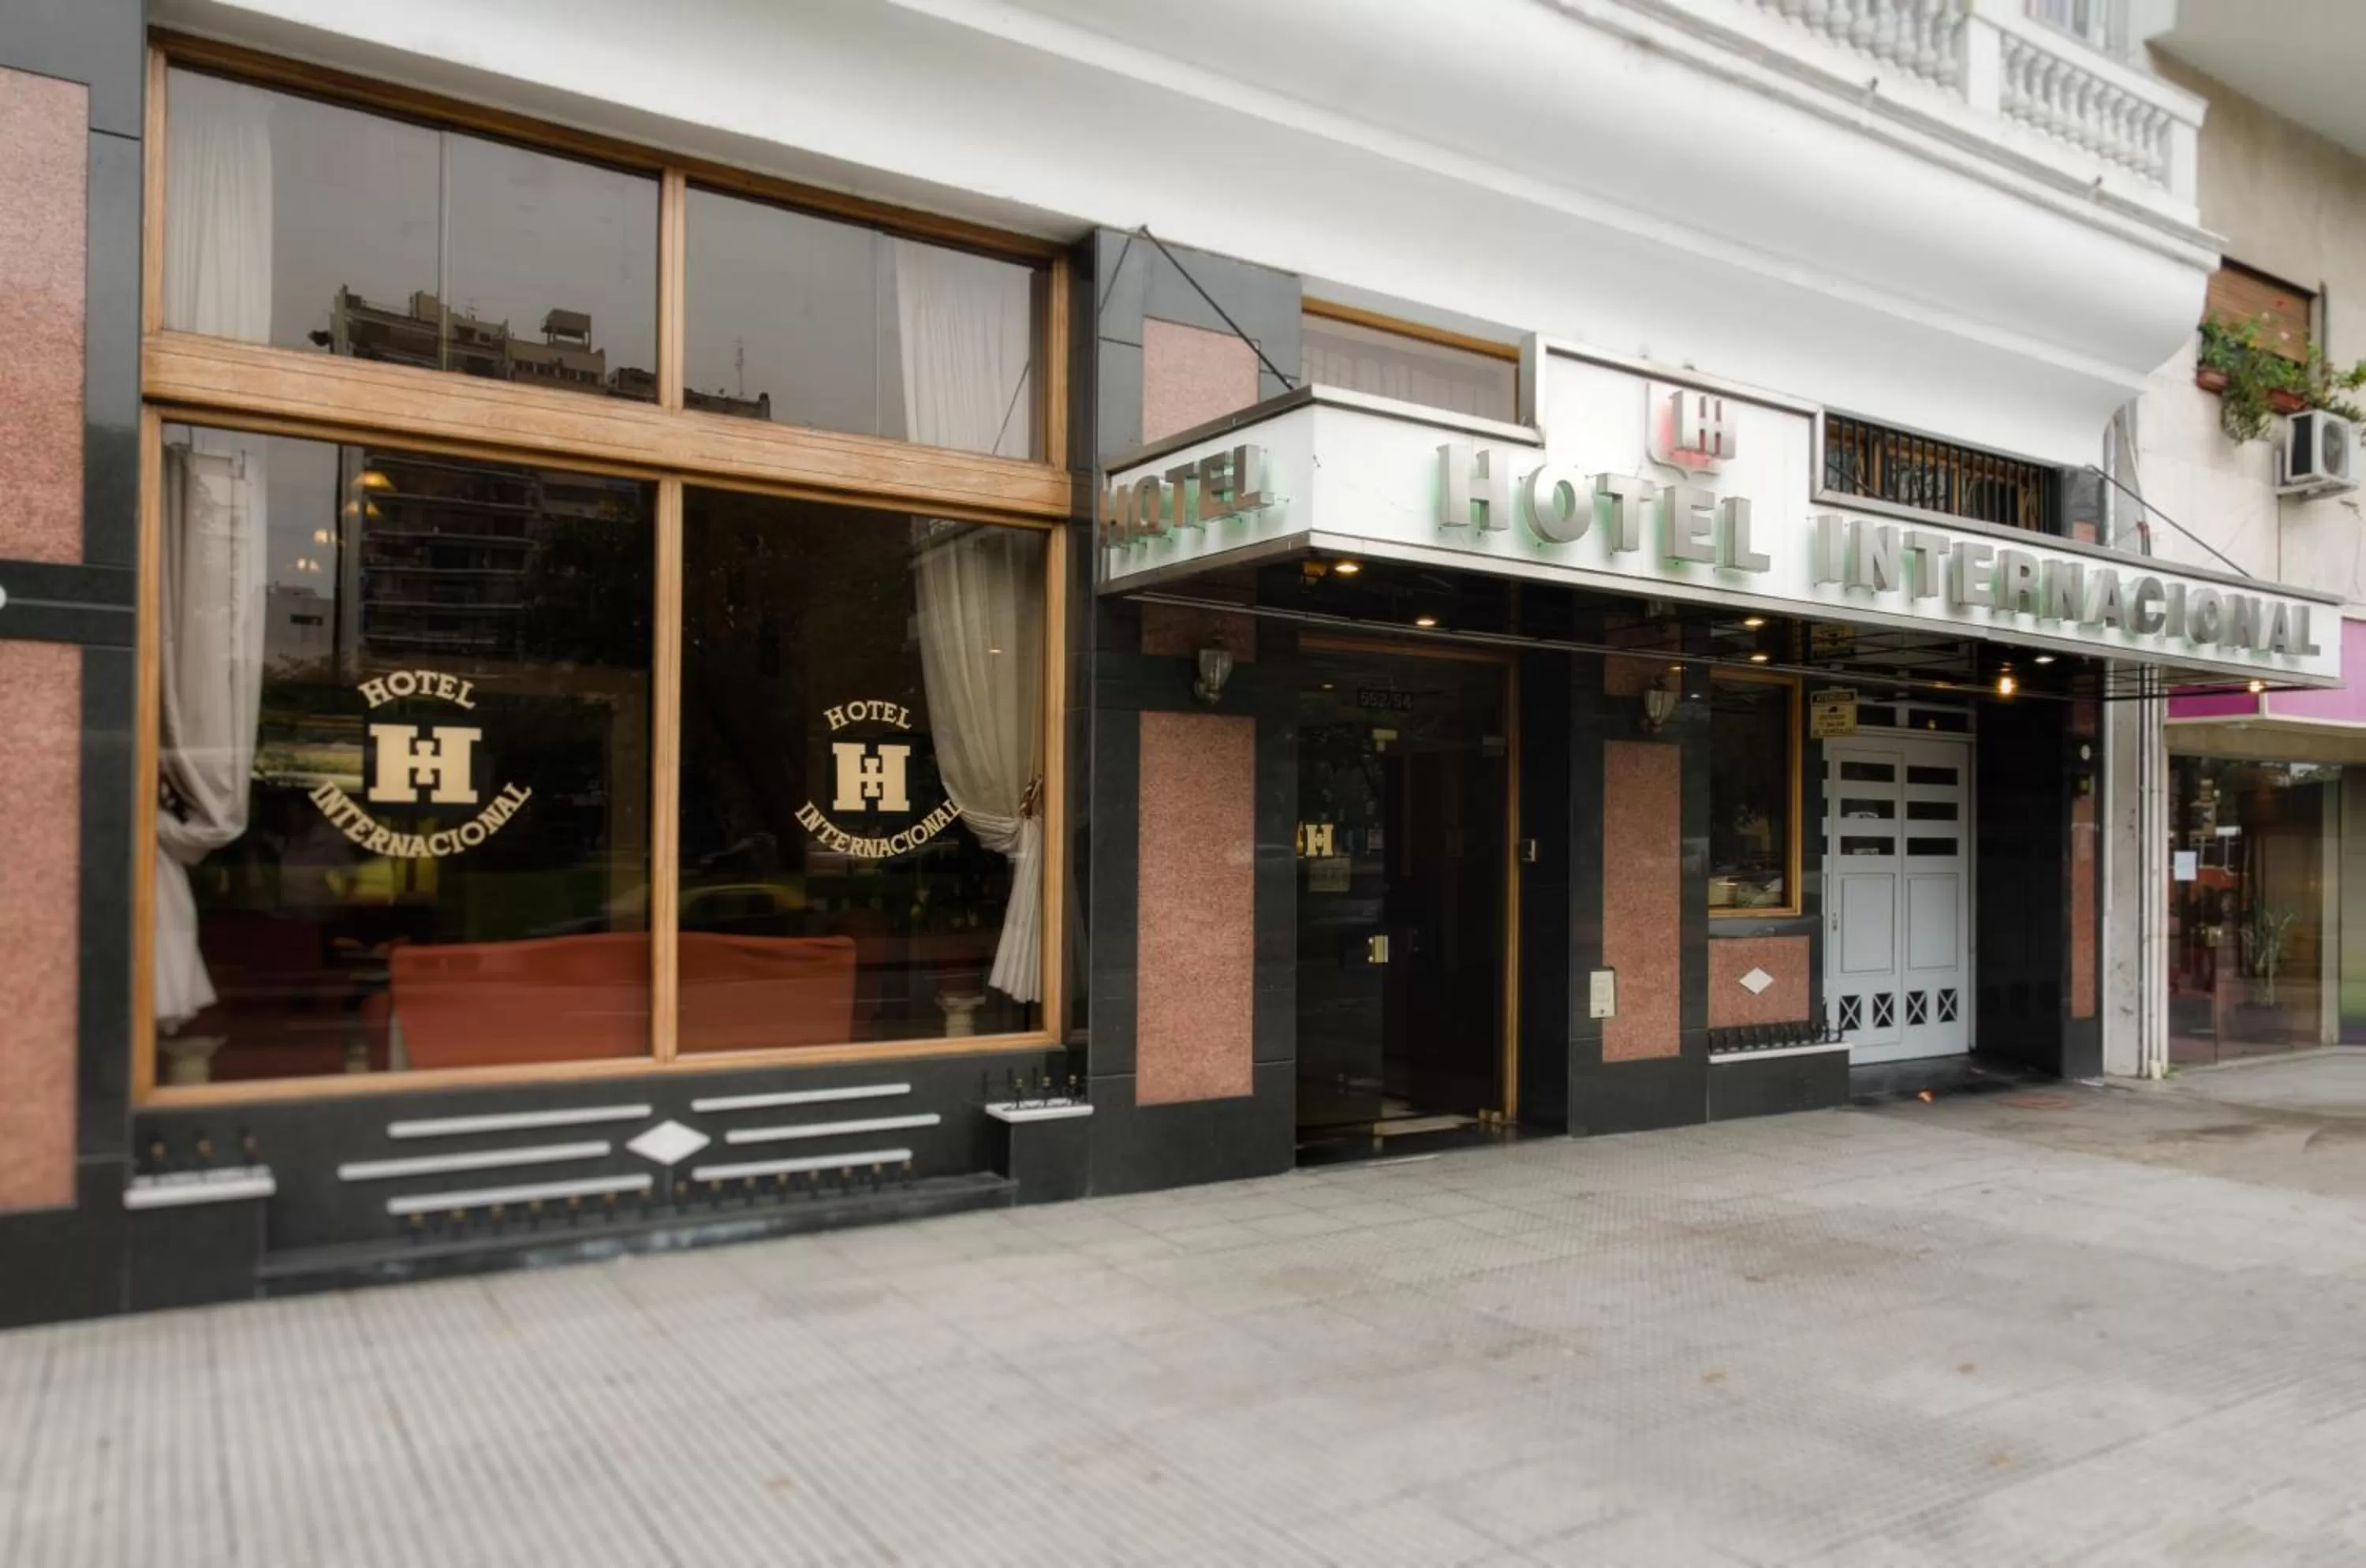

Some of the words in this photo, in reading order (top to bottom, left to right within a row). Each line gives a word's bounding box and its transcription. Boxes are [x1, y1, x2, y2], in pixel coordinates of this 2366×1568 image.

[1099, 443, 1275, 544] HOTEL
[1436, 443, 1771, 573] HOTEL
[1816, 515, 2320, 656] INTERNACIONAL
[357, 670, 476, 709] HOTEL
[823, 700, 912, 730] HOTEL
[308, 780, 532, 858] INTERNACIONAL
[794, 799, 964, 858] INTERNACIONAL
